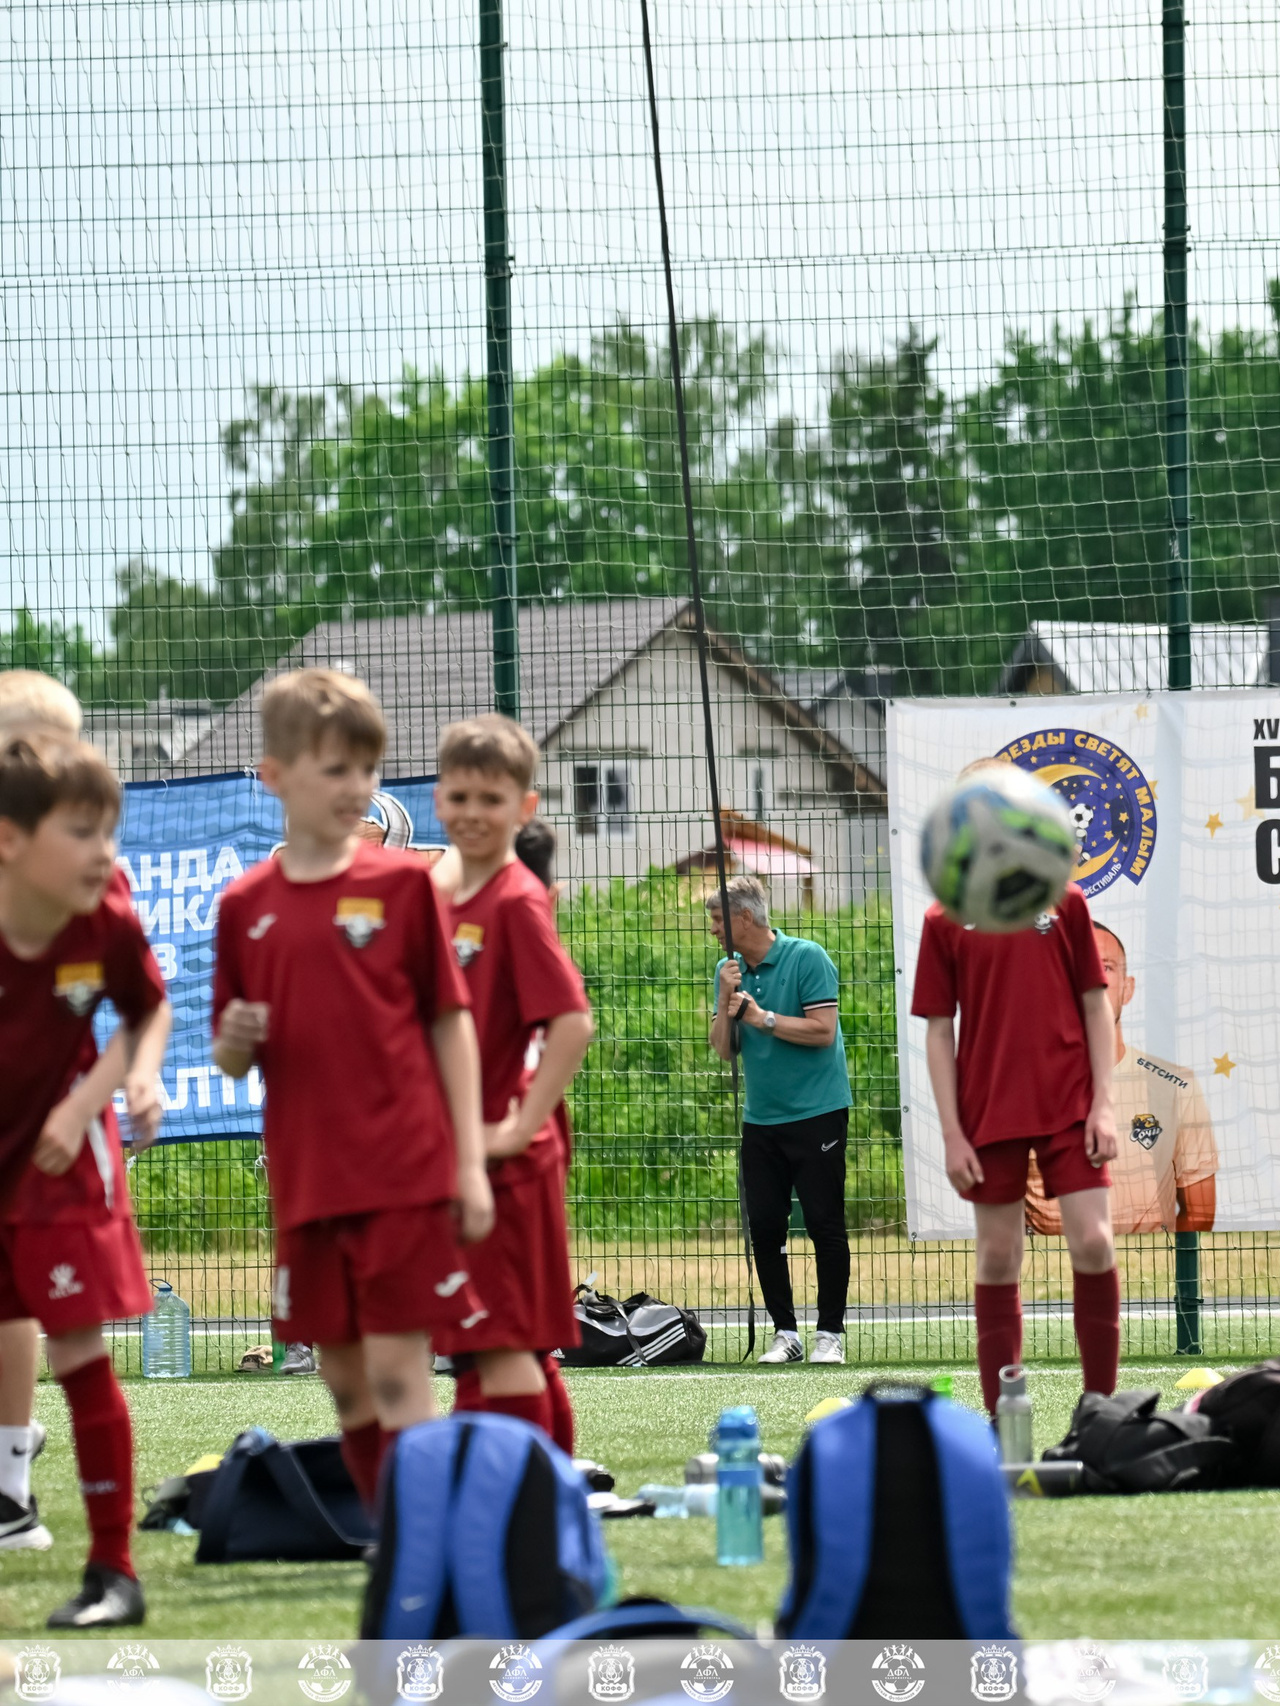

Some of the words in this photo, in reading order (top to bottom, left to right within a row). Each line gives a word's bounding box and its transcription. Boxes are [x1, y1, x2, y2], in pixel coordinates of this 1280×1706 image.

[1074, 733, 1140, 780] СВЕТЯТ
[1130, 786, 1154, 877] МАЛЫМ
[1137, 1057, 1188, 1089] БЕТСИТИ
